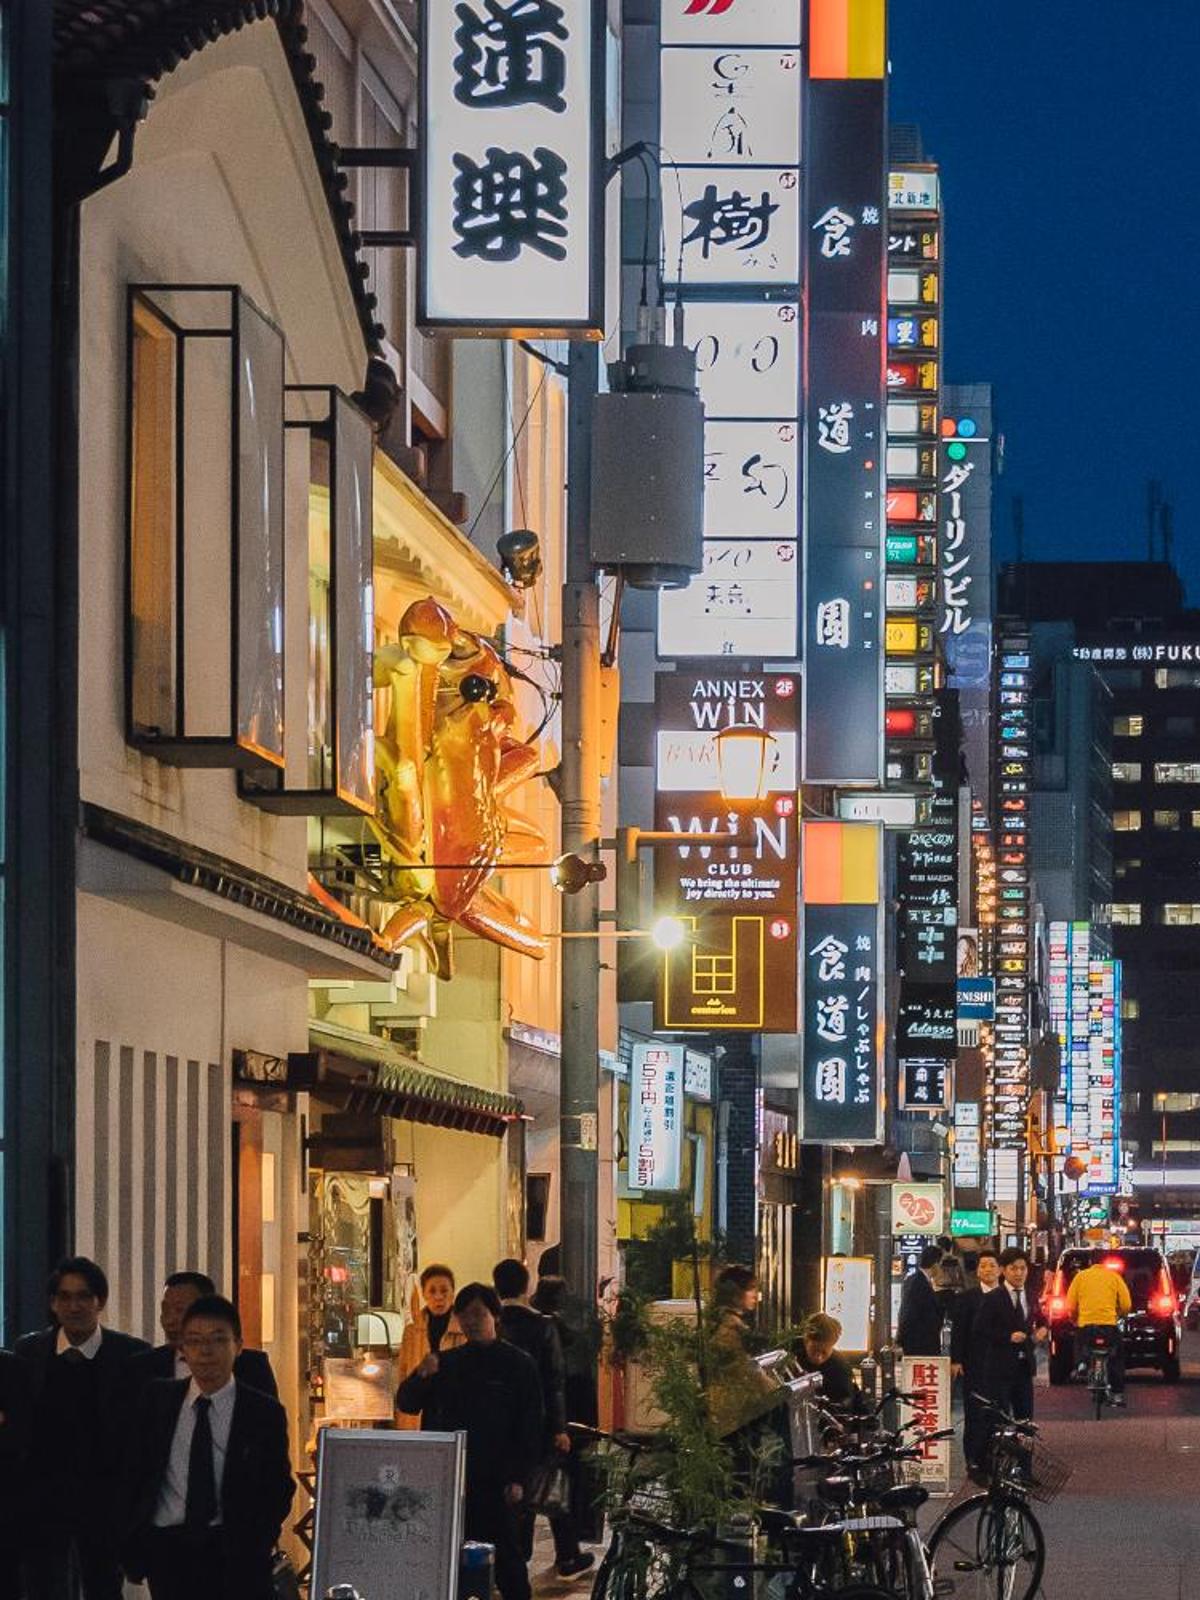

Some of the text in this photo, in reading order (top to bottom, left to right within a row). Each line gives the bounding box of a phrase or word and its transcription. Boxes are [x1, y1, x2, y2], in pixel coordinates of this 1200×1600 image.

[893, 192, 931, 206] 北新地
[683, 184, 780, 259] 樹
[812, 206, 855, 649] 食道園
[940, 462, 975, 635] ダーリンビル
[692, 680, 766, 698] ANNEX
[707, 863, 753, 875] CLUB
[680, 878, 780, 890] We bring the ultimate
[686, 889, 702, 901] joy
[703, 889, 741, 901] directly
[742, 890, 753, 899] to
[810, 935, 849, 1104] 食道園
